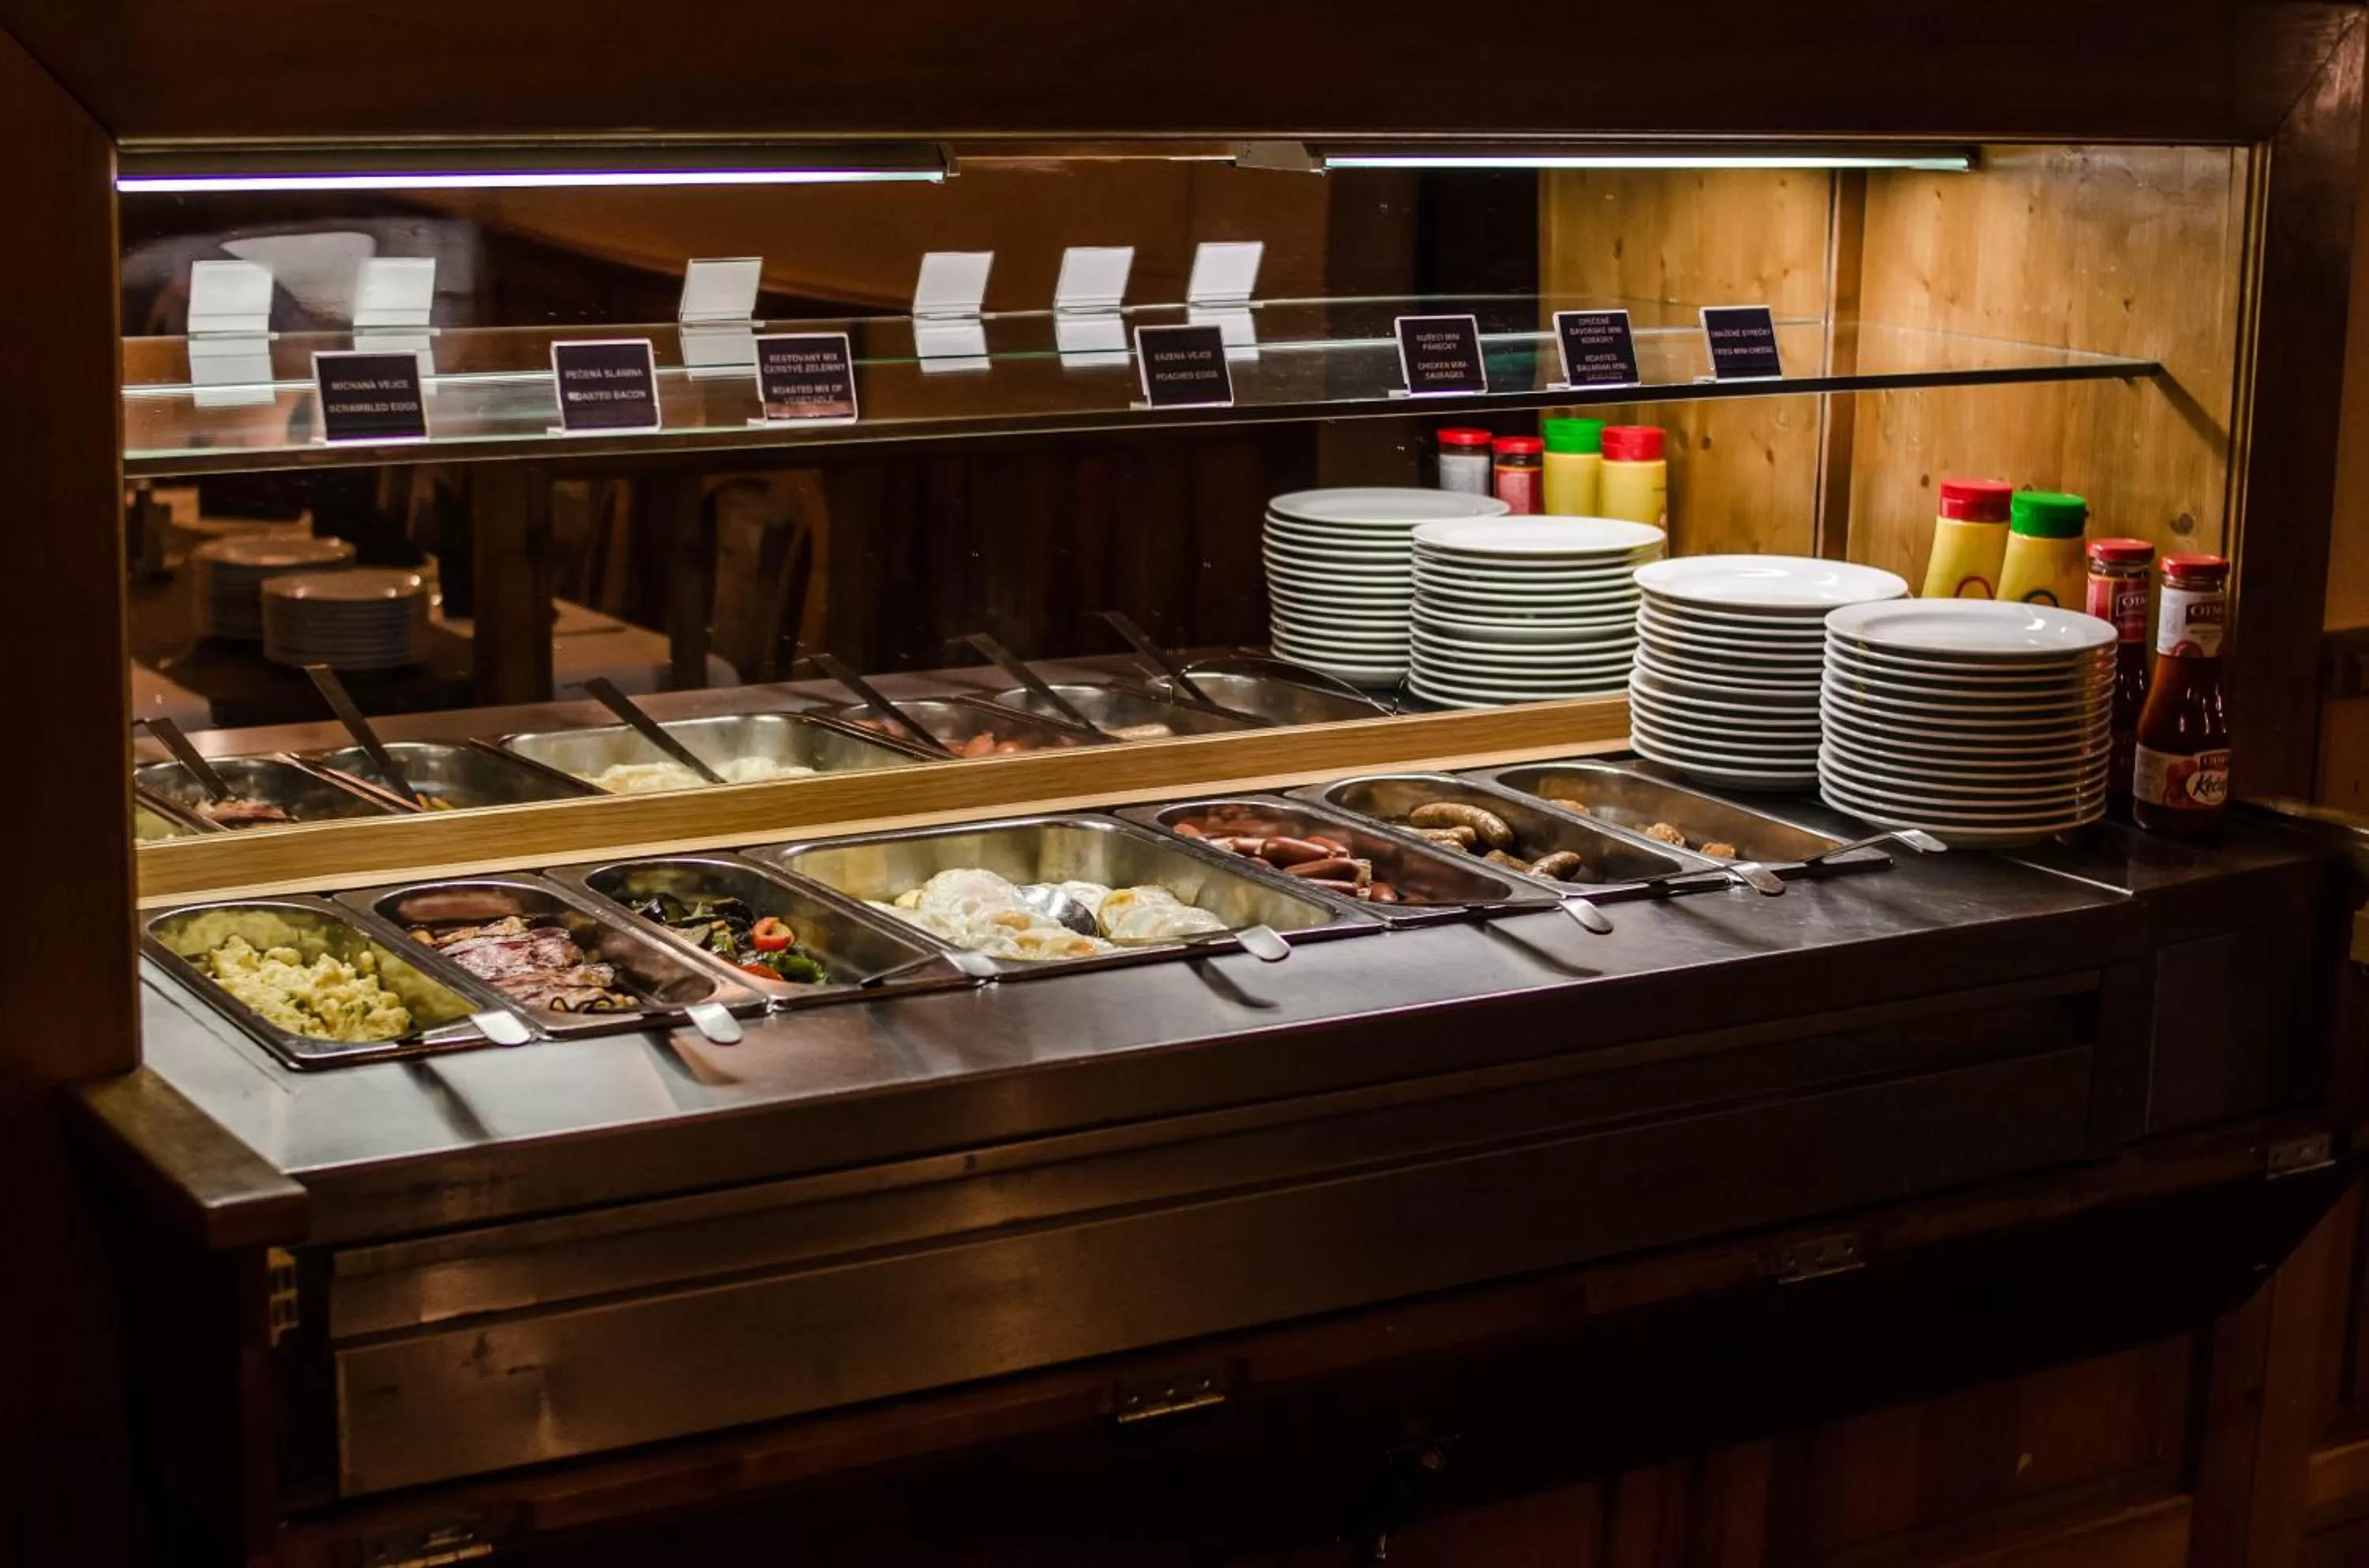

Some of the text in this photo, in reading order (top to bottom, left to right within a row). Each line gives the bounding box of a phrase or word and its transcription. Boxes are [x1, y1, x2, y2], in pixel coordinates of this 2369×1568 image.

[769, 352, 820, 363] RESTOVANÝ
[1187, 351, 1212, 359] VEJCE
[565, 368, 644, 379] PEČENÁ SLANINA
[805, 364, 846, 373] ZELENINY
[377, 379, 409, 389] VEJCE
[772, 385, 813, 394] ROASTED
[568, 390, 647, 402] ROASTED BACON
[329, 401, 418, 413] SCRAMBLED EGGS
[2190, 606, 2223, 617] OTM
